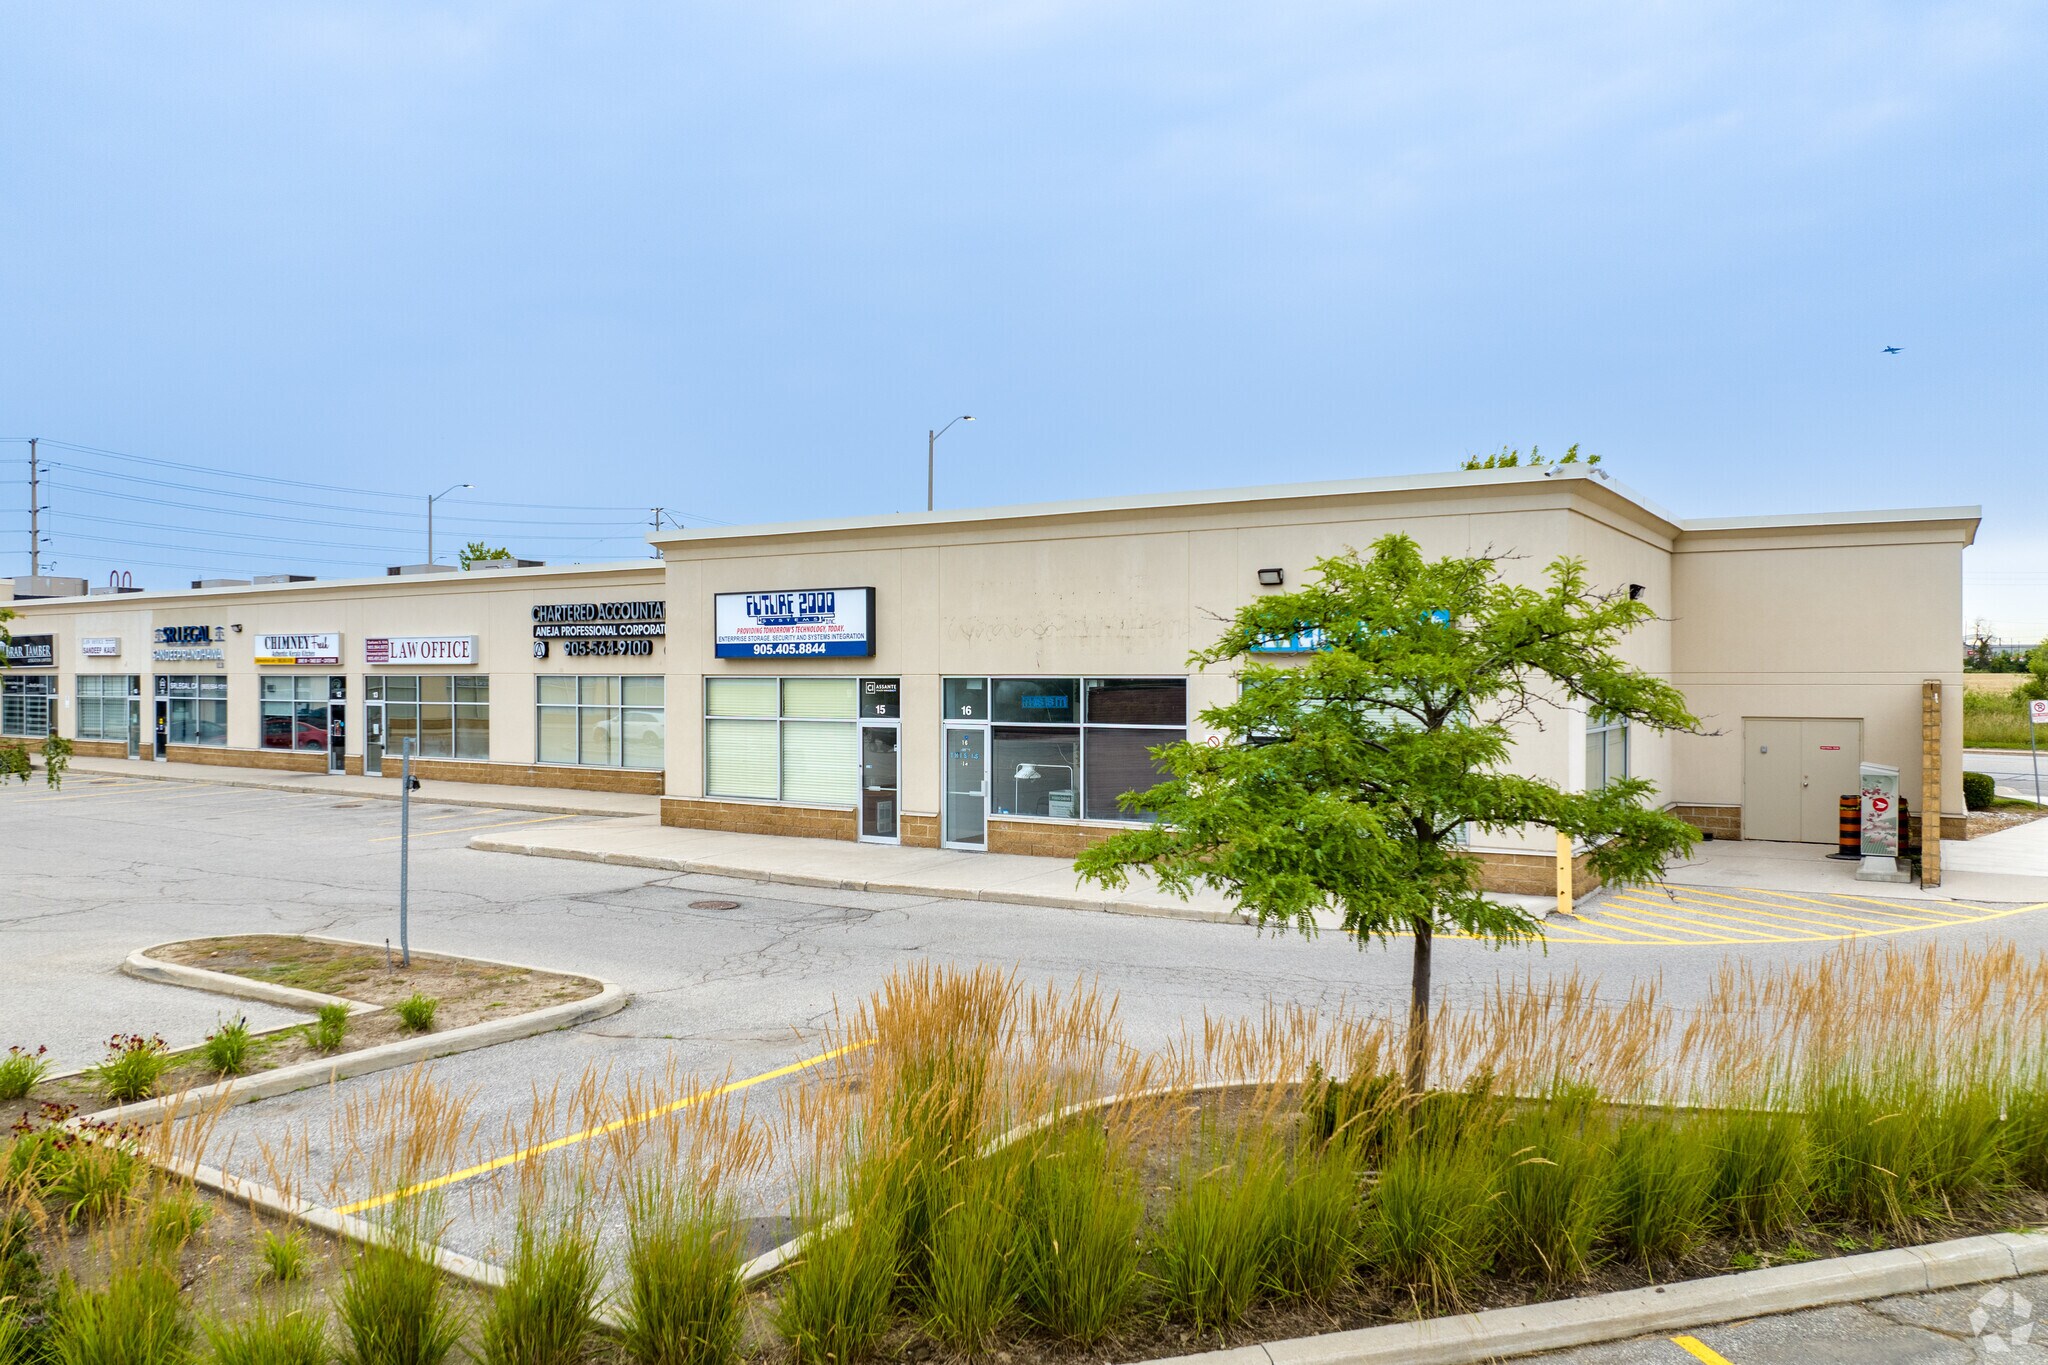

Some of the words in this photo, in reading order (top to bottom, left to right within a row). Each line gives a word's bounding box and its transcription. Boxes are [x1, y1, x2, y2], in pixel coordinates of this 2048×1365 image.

[746, 593, 794, 616] FUTURE
[798, 592, 835, 614] 2000
[532, 604, 597, 622] CHARTERED
[598, 601, 666, 620] ACCOUNTA
[535, 625, 560, 637] ANEJA
[561, 624, 618, 636] PROFESSIONAL
[736, 627, 763, 635] PROVIDING
[763, 626, 795, 634] TOMORROW'S
[772, 633, 796, 641] SECURITY
[796, 633, 807, 641] AND
[831, 632, 865, 640] INTEGRATION
[264, 635, 310, 650] CHIMNEY
[563, 640, 653, 656] 905-564-9100
[753, 643, 826, 655] 905.405.8844
[391, 642, 418, 659] LAW
[420, 640, 470, 659] OFFICE
[875, 704, 886, 715] 15
[961, 705, 973, 716] 16
